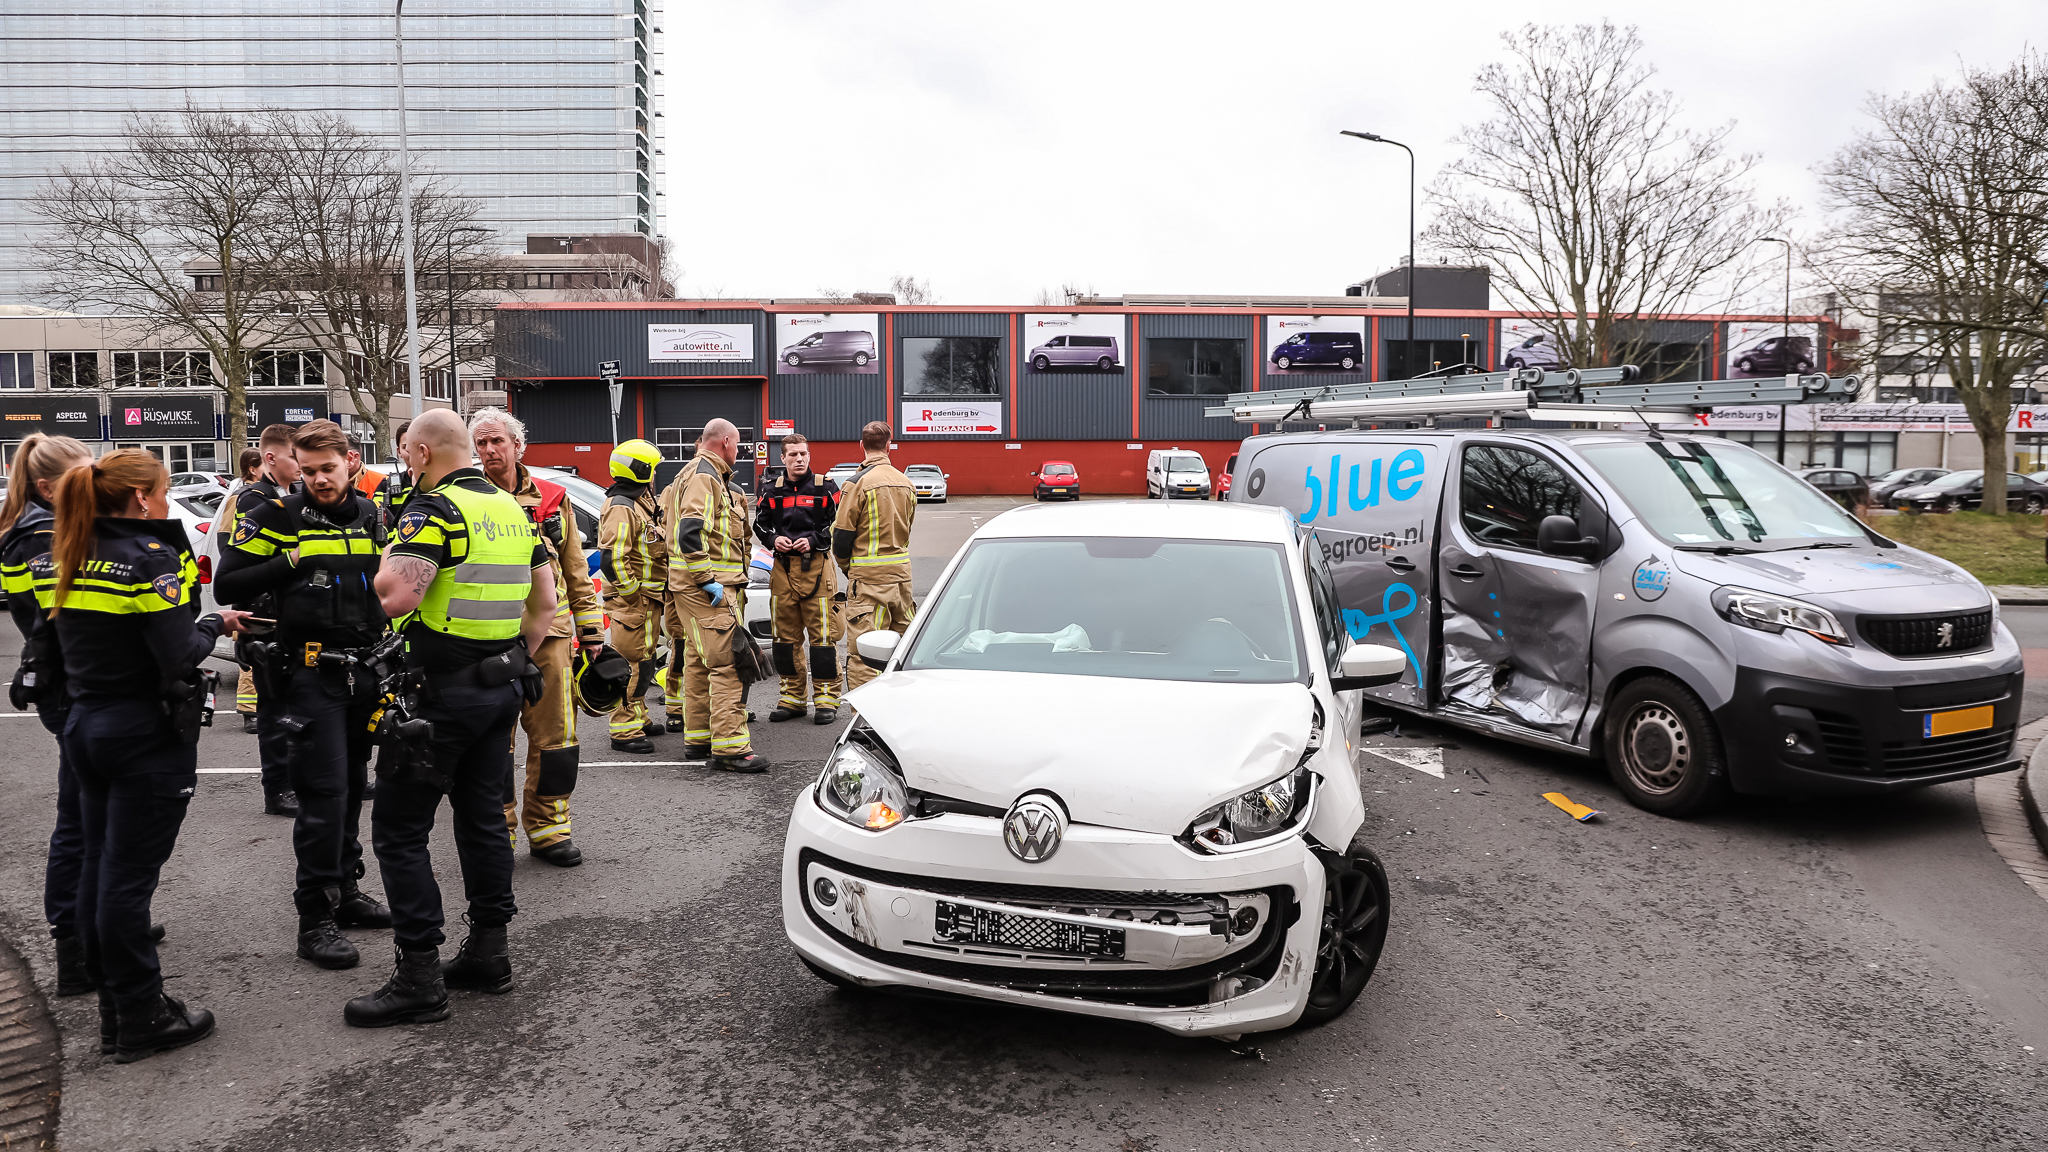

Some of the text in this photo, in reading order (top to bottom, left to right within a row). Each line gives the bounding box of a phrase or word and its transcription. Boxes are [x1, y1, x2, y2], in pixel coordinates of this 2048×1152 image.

[673, 341, 733, 351] autowitte.nl
[55, 411, 88, 420] ASPECTA
[922, 409, 969, 421] Redenburg
[1766, 411, 1779, 419] bv
[1300, 448, 1426, 525] blue
[472, 520, 531, 541] POLITIE
[1637, 568, 1667, 583] 24/7
[1635, 582, 1665, 592] service
